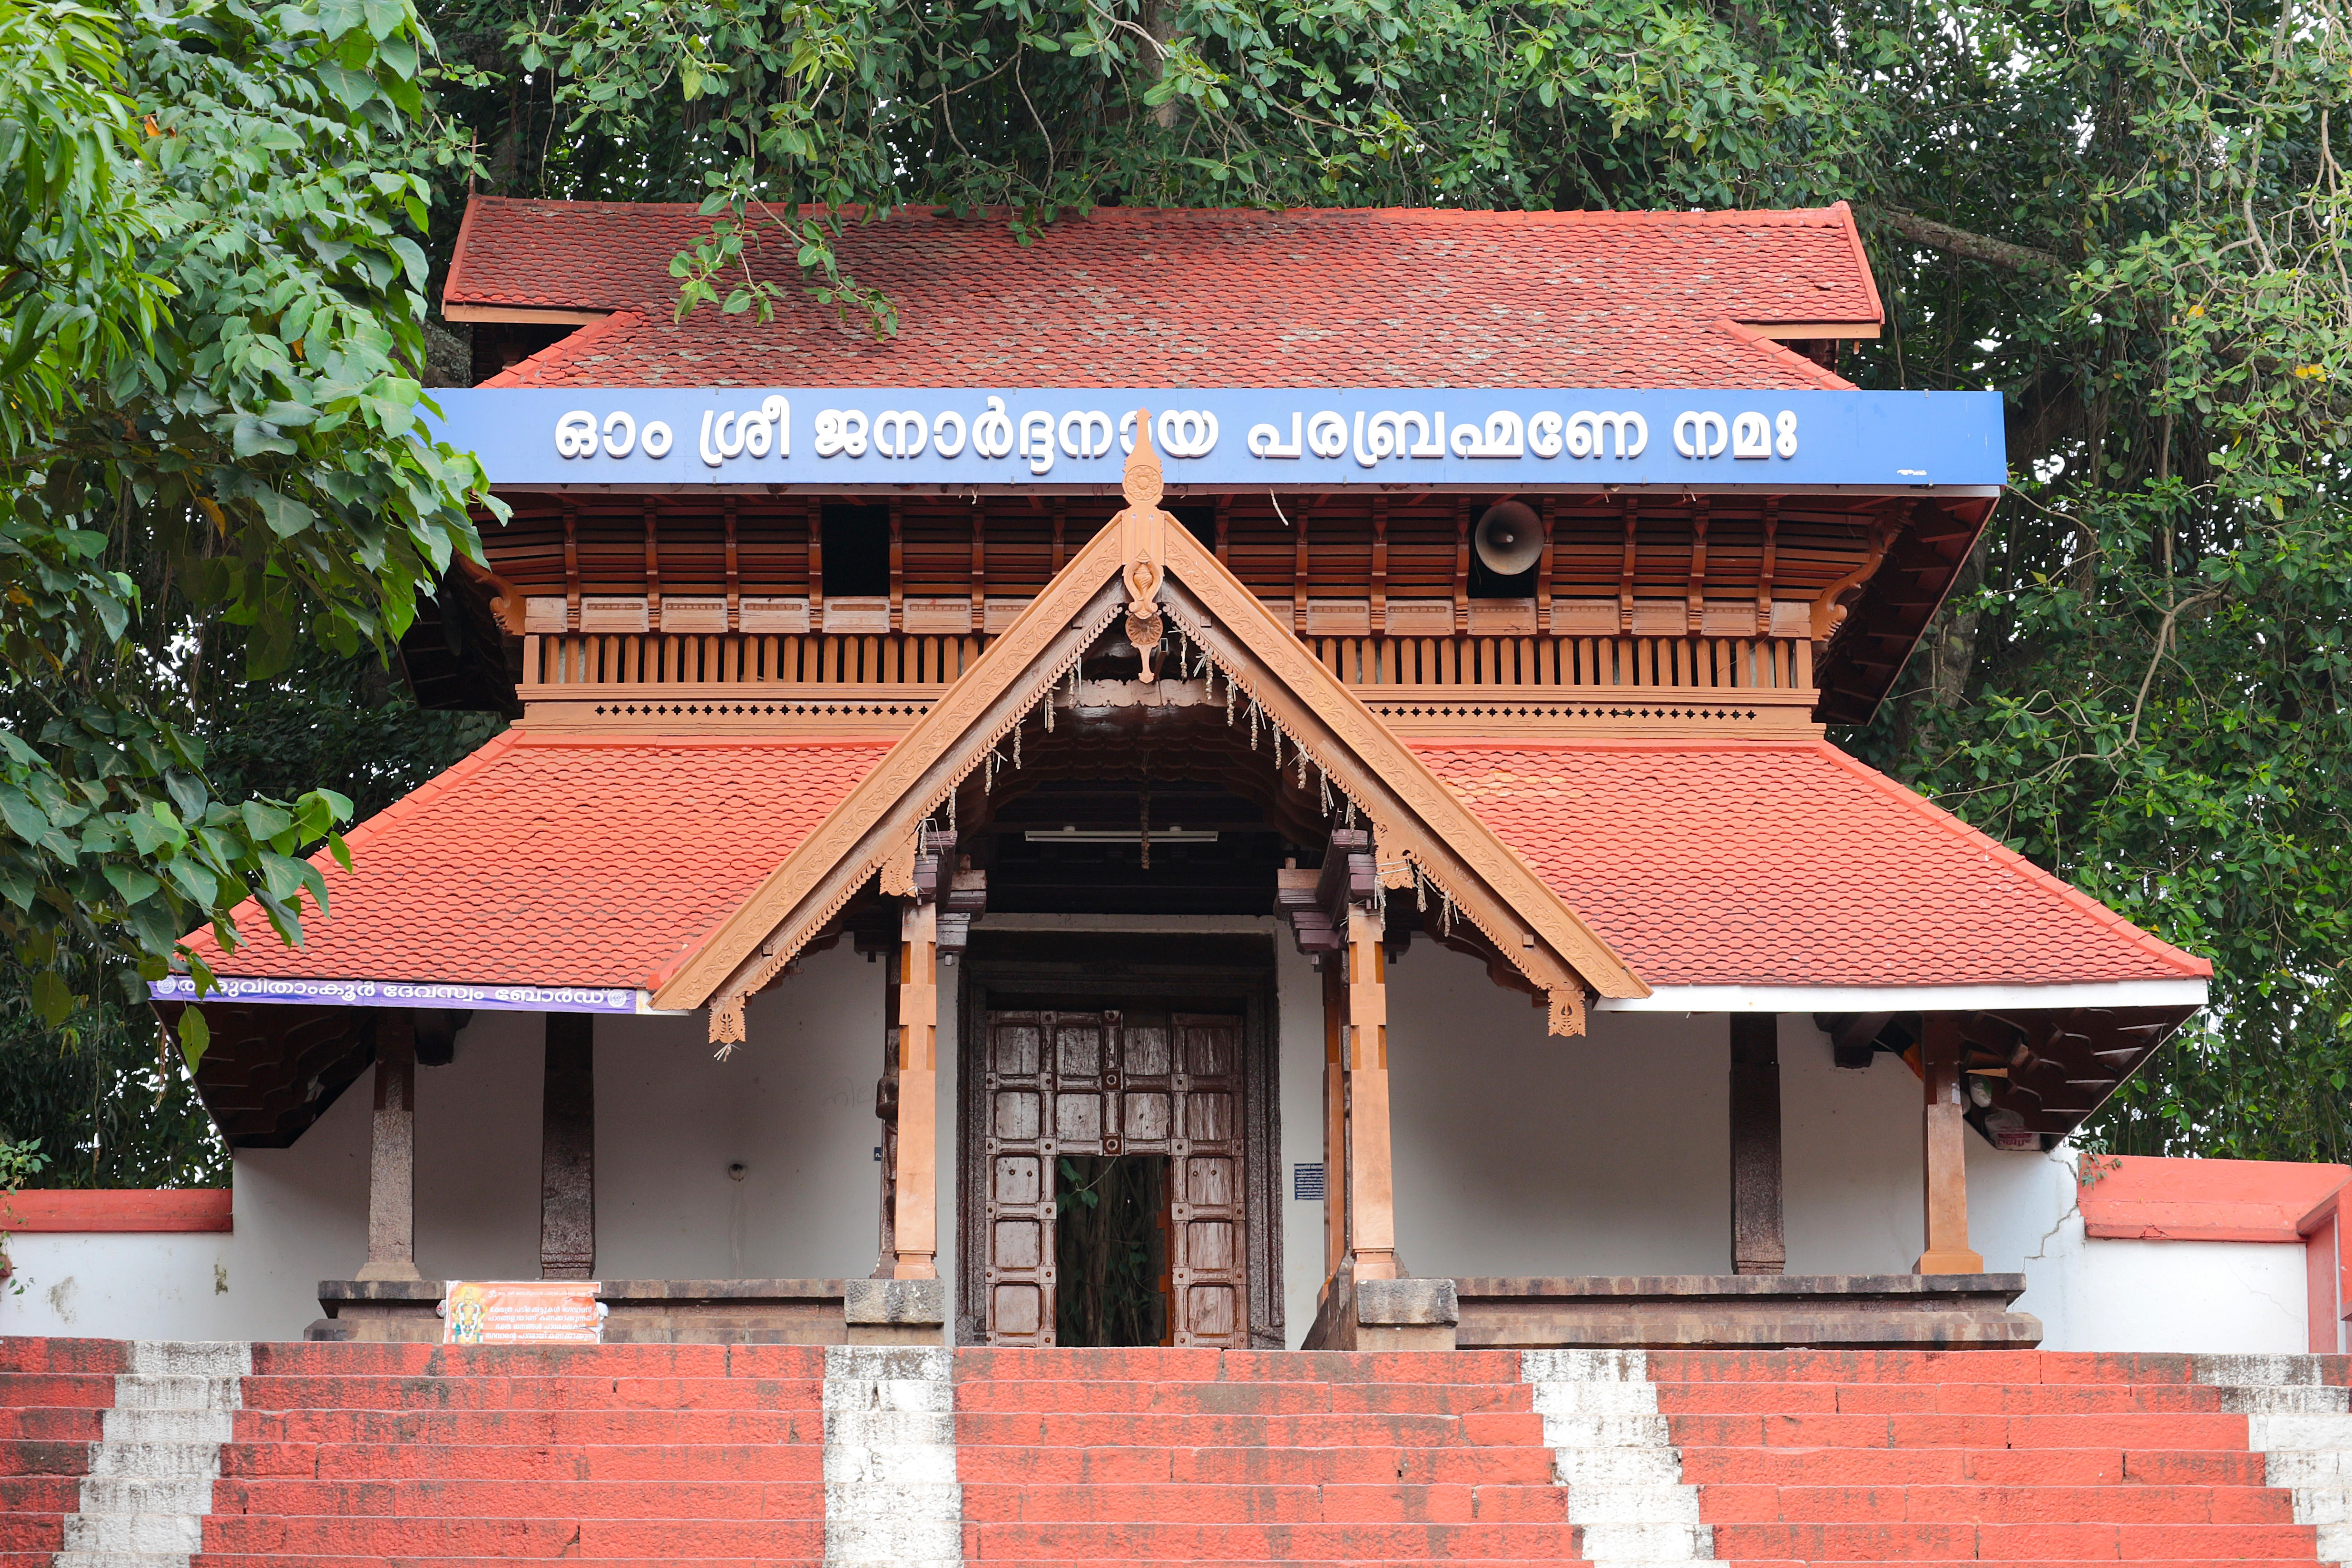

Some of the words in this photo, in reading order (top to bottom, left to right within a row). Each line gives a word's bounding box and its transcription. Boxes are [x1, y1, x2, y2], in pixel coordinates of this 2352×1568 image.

[554, 409, 674, 457] ഓം
[699, 395, 790, 466] ശ്രീ
[1247, 410, 1649, 467] പരബ്രഹ്മണേ
[1673, 410, 1798, 458] നമഃ
[177, 977, 376, 1001] തരുവിതാംകൂർ
[383, 985, 485, 1002] ദേവസ്വം
[495, 986, 611, 1004] ബോർഡ്
